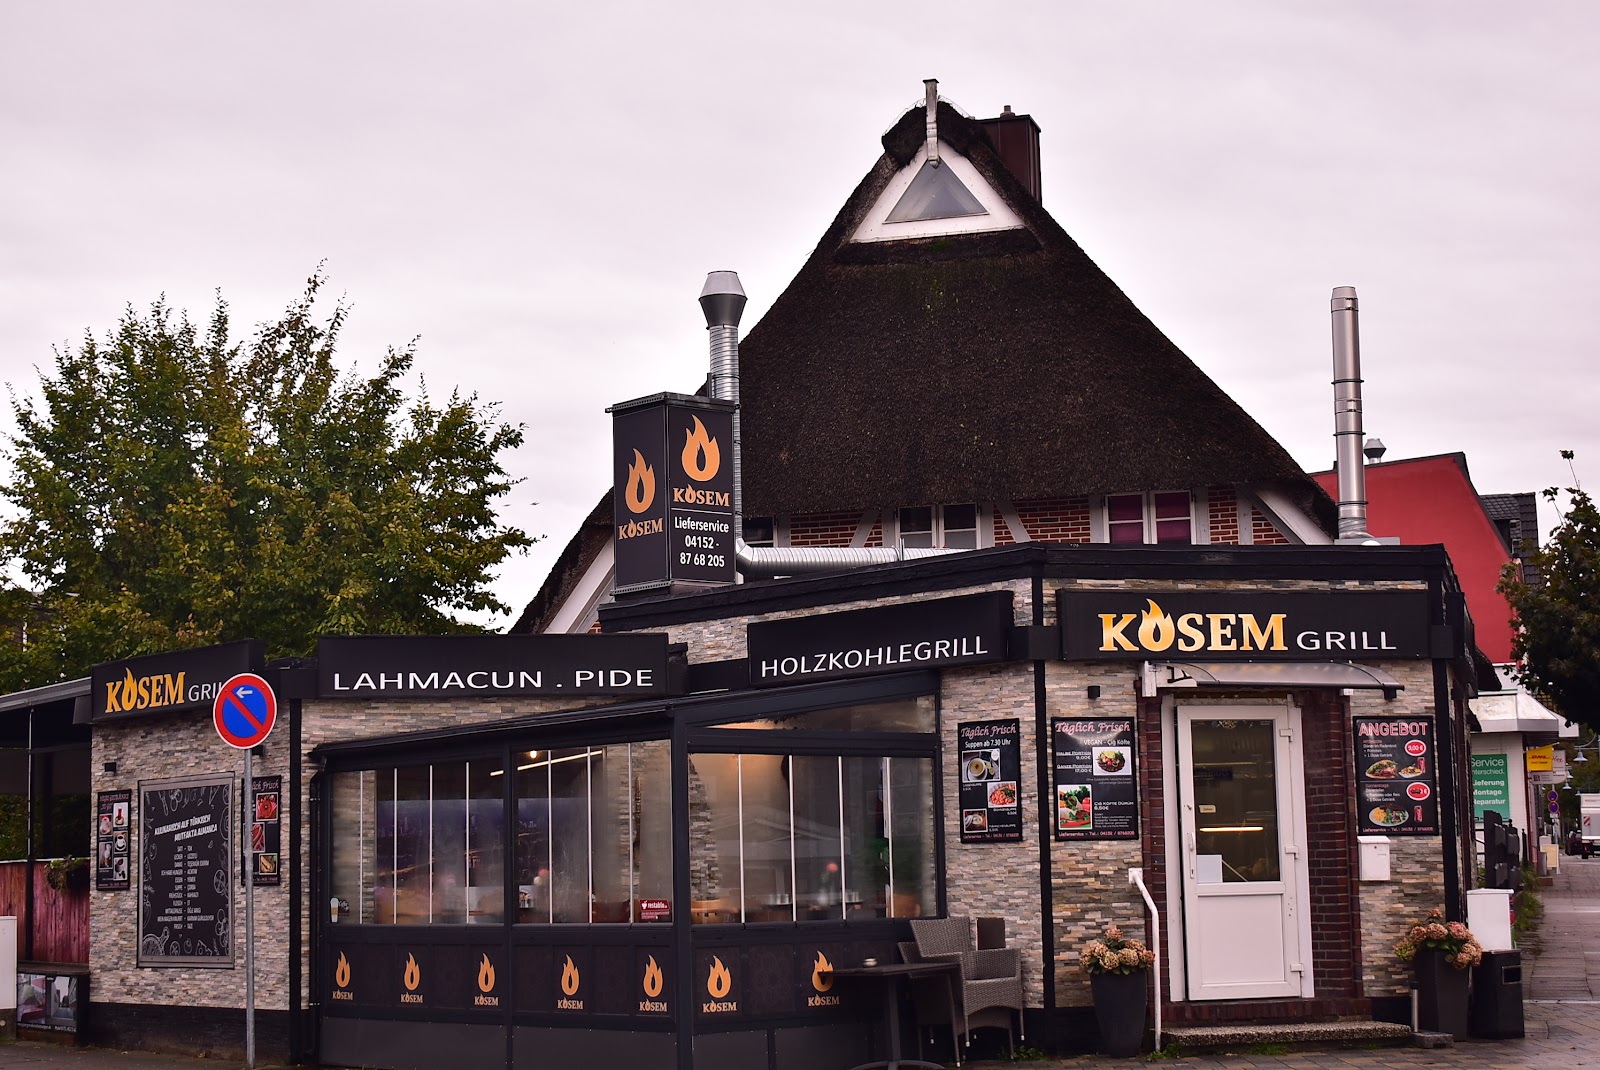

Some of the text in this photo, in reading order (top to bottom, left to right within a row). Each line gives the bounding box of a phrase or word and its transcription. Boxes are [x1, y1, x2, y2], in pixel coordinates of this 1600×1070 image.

[675, 517, 729, 533] Lieferservice
[685, 536, 714, 549] 04152
[680, 552, 725, 567] 87 68 205
[1296, 631, 1397, 650] GRILL
[761, 636, 988, 678] HOLZKOHLEGRILL
[334, 670, 542, 690] LAHMACUN
[575, 669, 653, 688] PIDE
[188, 682, 223, 702] GRI
[961, 723, 1016, 739] Täglich Frisch
[1055, 721, 1130, 735] Täglich Frisch
[1359, 722, 1428, 736] ANGEBOT
[965, 740, 983, 749] Suppen
[1471, 758, 1504, 766] Service
